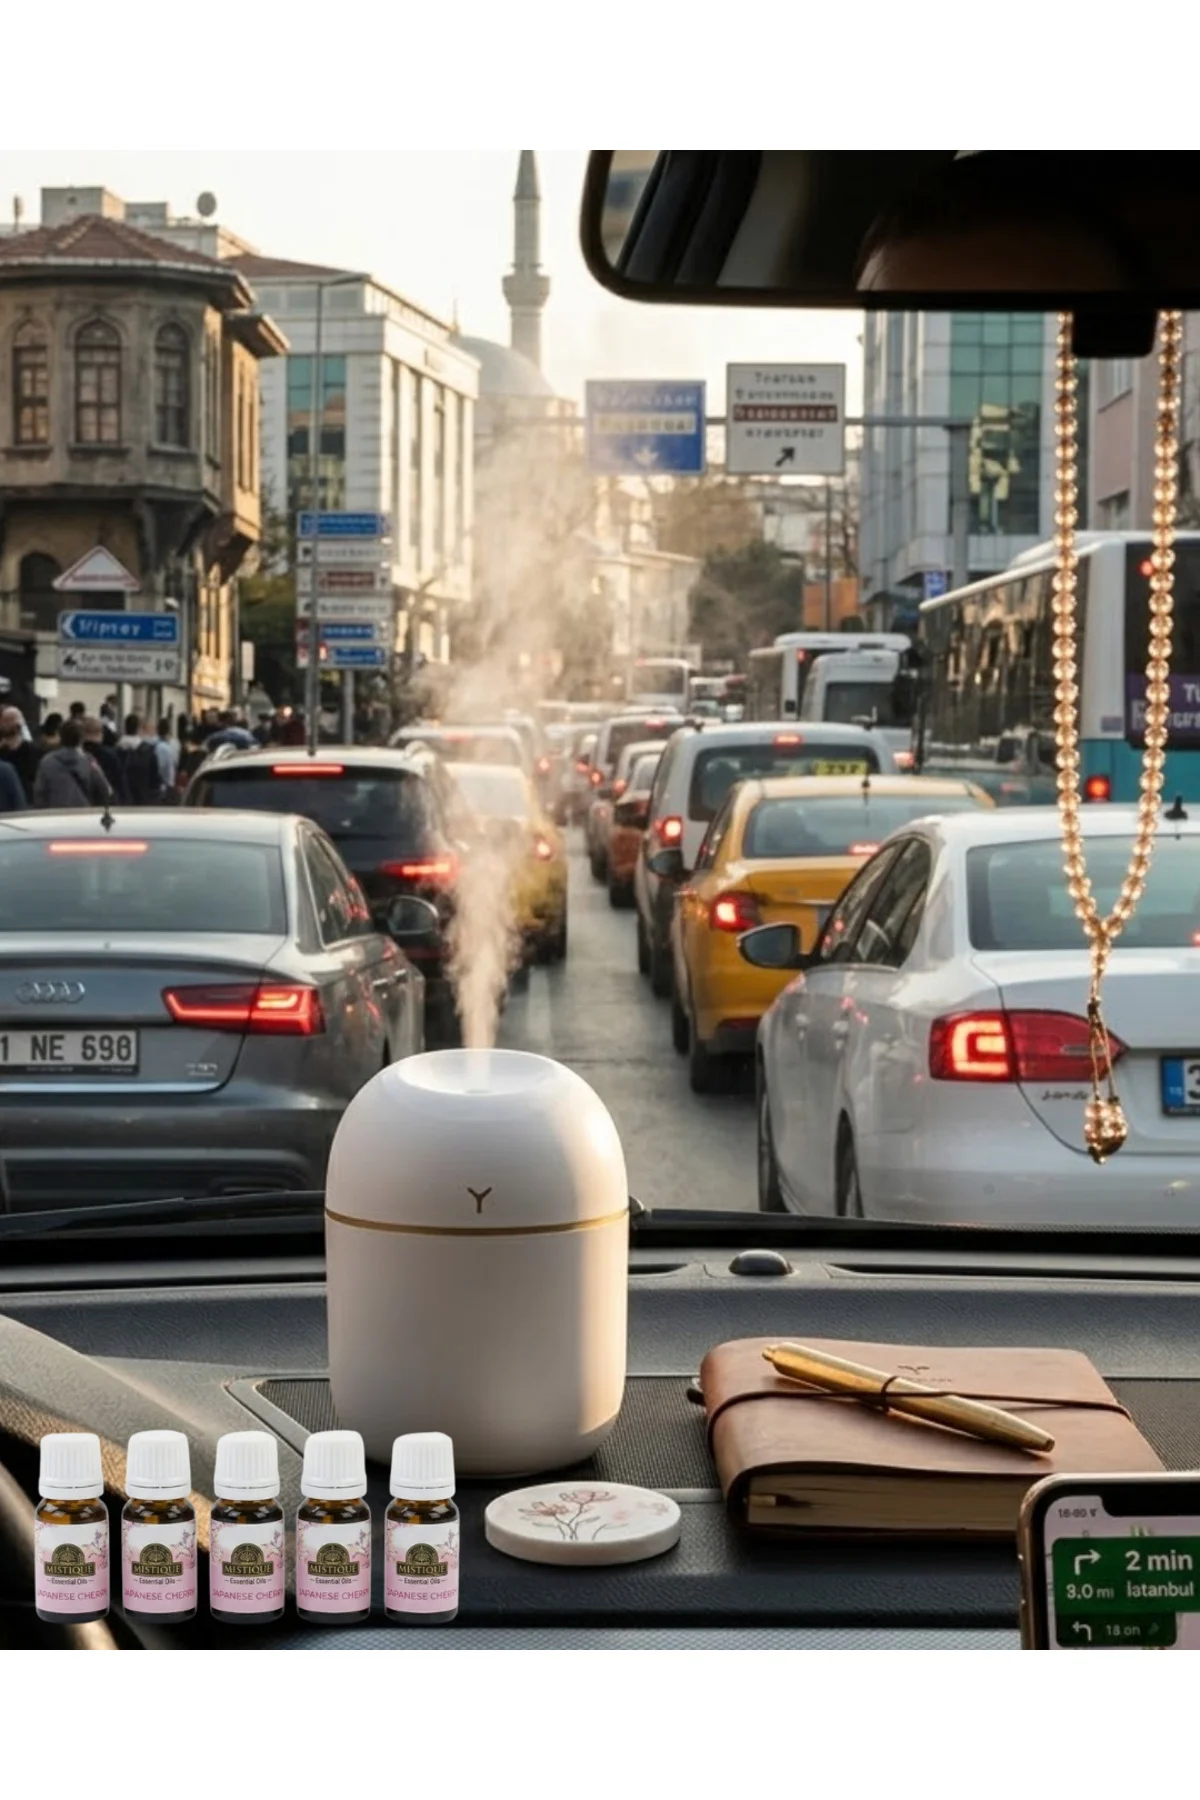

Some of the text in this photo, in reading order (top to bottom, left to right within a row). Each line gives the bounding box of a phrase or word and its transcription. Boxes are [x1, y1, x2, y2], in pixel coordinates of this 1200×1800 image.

[31, 1034, 65, 1061] NE
[1125, 1549, 1193, 1571] 2 min
[46, 1564, 93, 1576] MISTIQUE
[133, 1564, 180, 1576] MISTIQUE
[224, 1564, 271, 1576] MISTIQUE
[310, 1564, 357, 1576] MISTIQUE
[399, 1564, 446, 1576] MISTIQUE
[1066, 1584, 1093, 1599] 3.0
